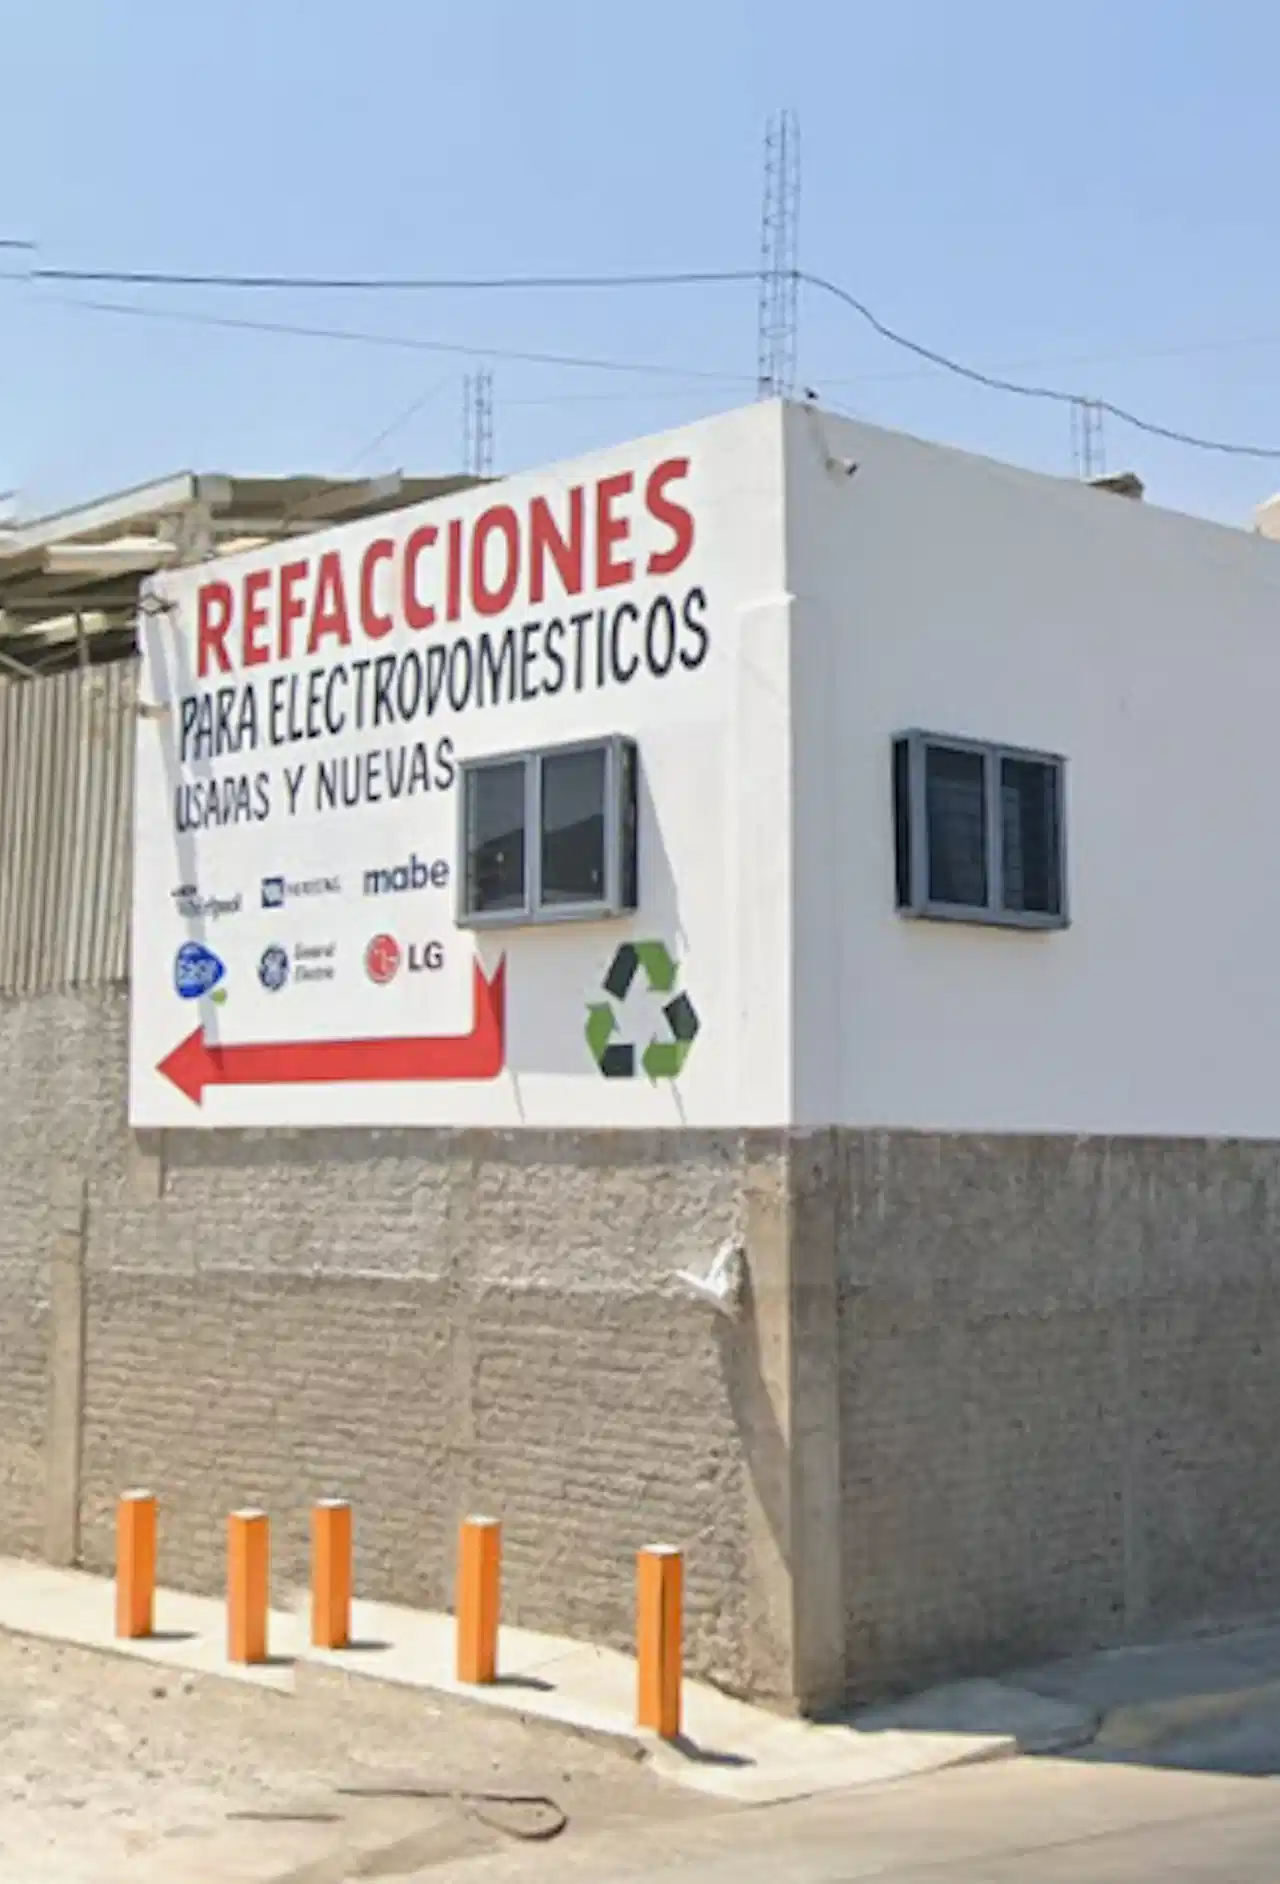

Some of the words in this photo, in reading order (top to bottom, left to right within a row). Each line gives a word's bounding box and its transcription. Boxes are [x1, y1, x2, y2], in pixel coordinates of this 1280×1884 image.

[195, 456, 696, 679] REFACCIONES
[179, 678, 258, 763] PARA
[268, 586, 710, 747] ELECTRODOMESTICOS
[176, 771, 270, 833] USADAS
[284, 761, 305, 816] Y
[316, 736, 456, 813] NUEVAS
[363, 853, 450, 895] mabe
[408, 940, 445, 971] LG
